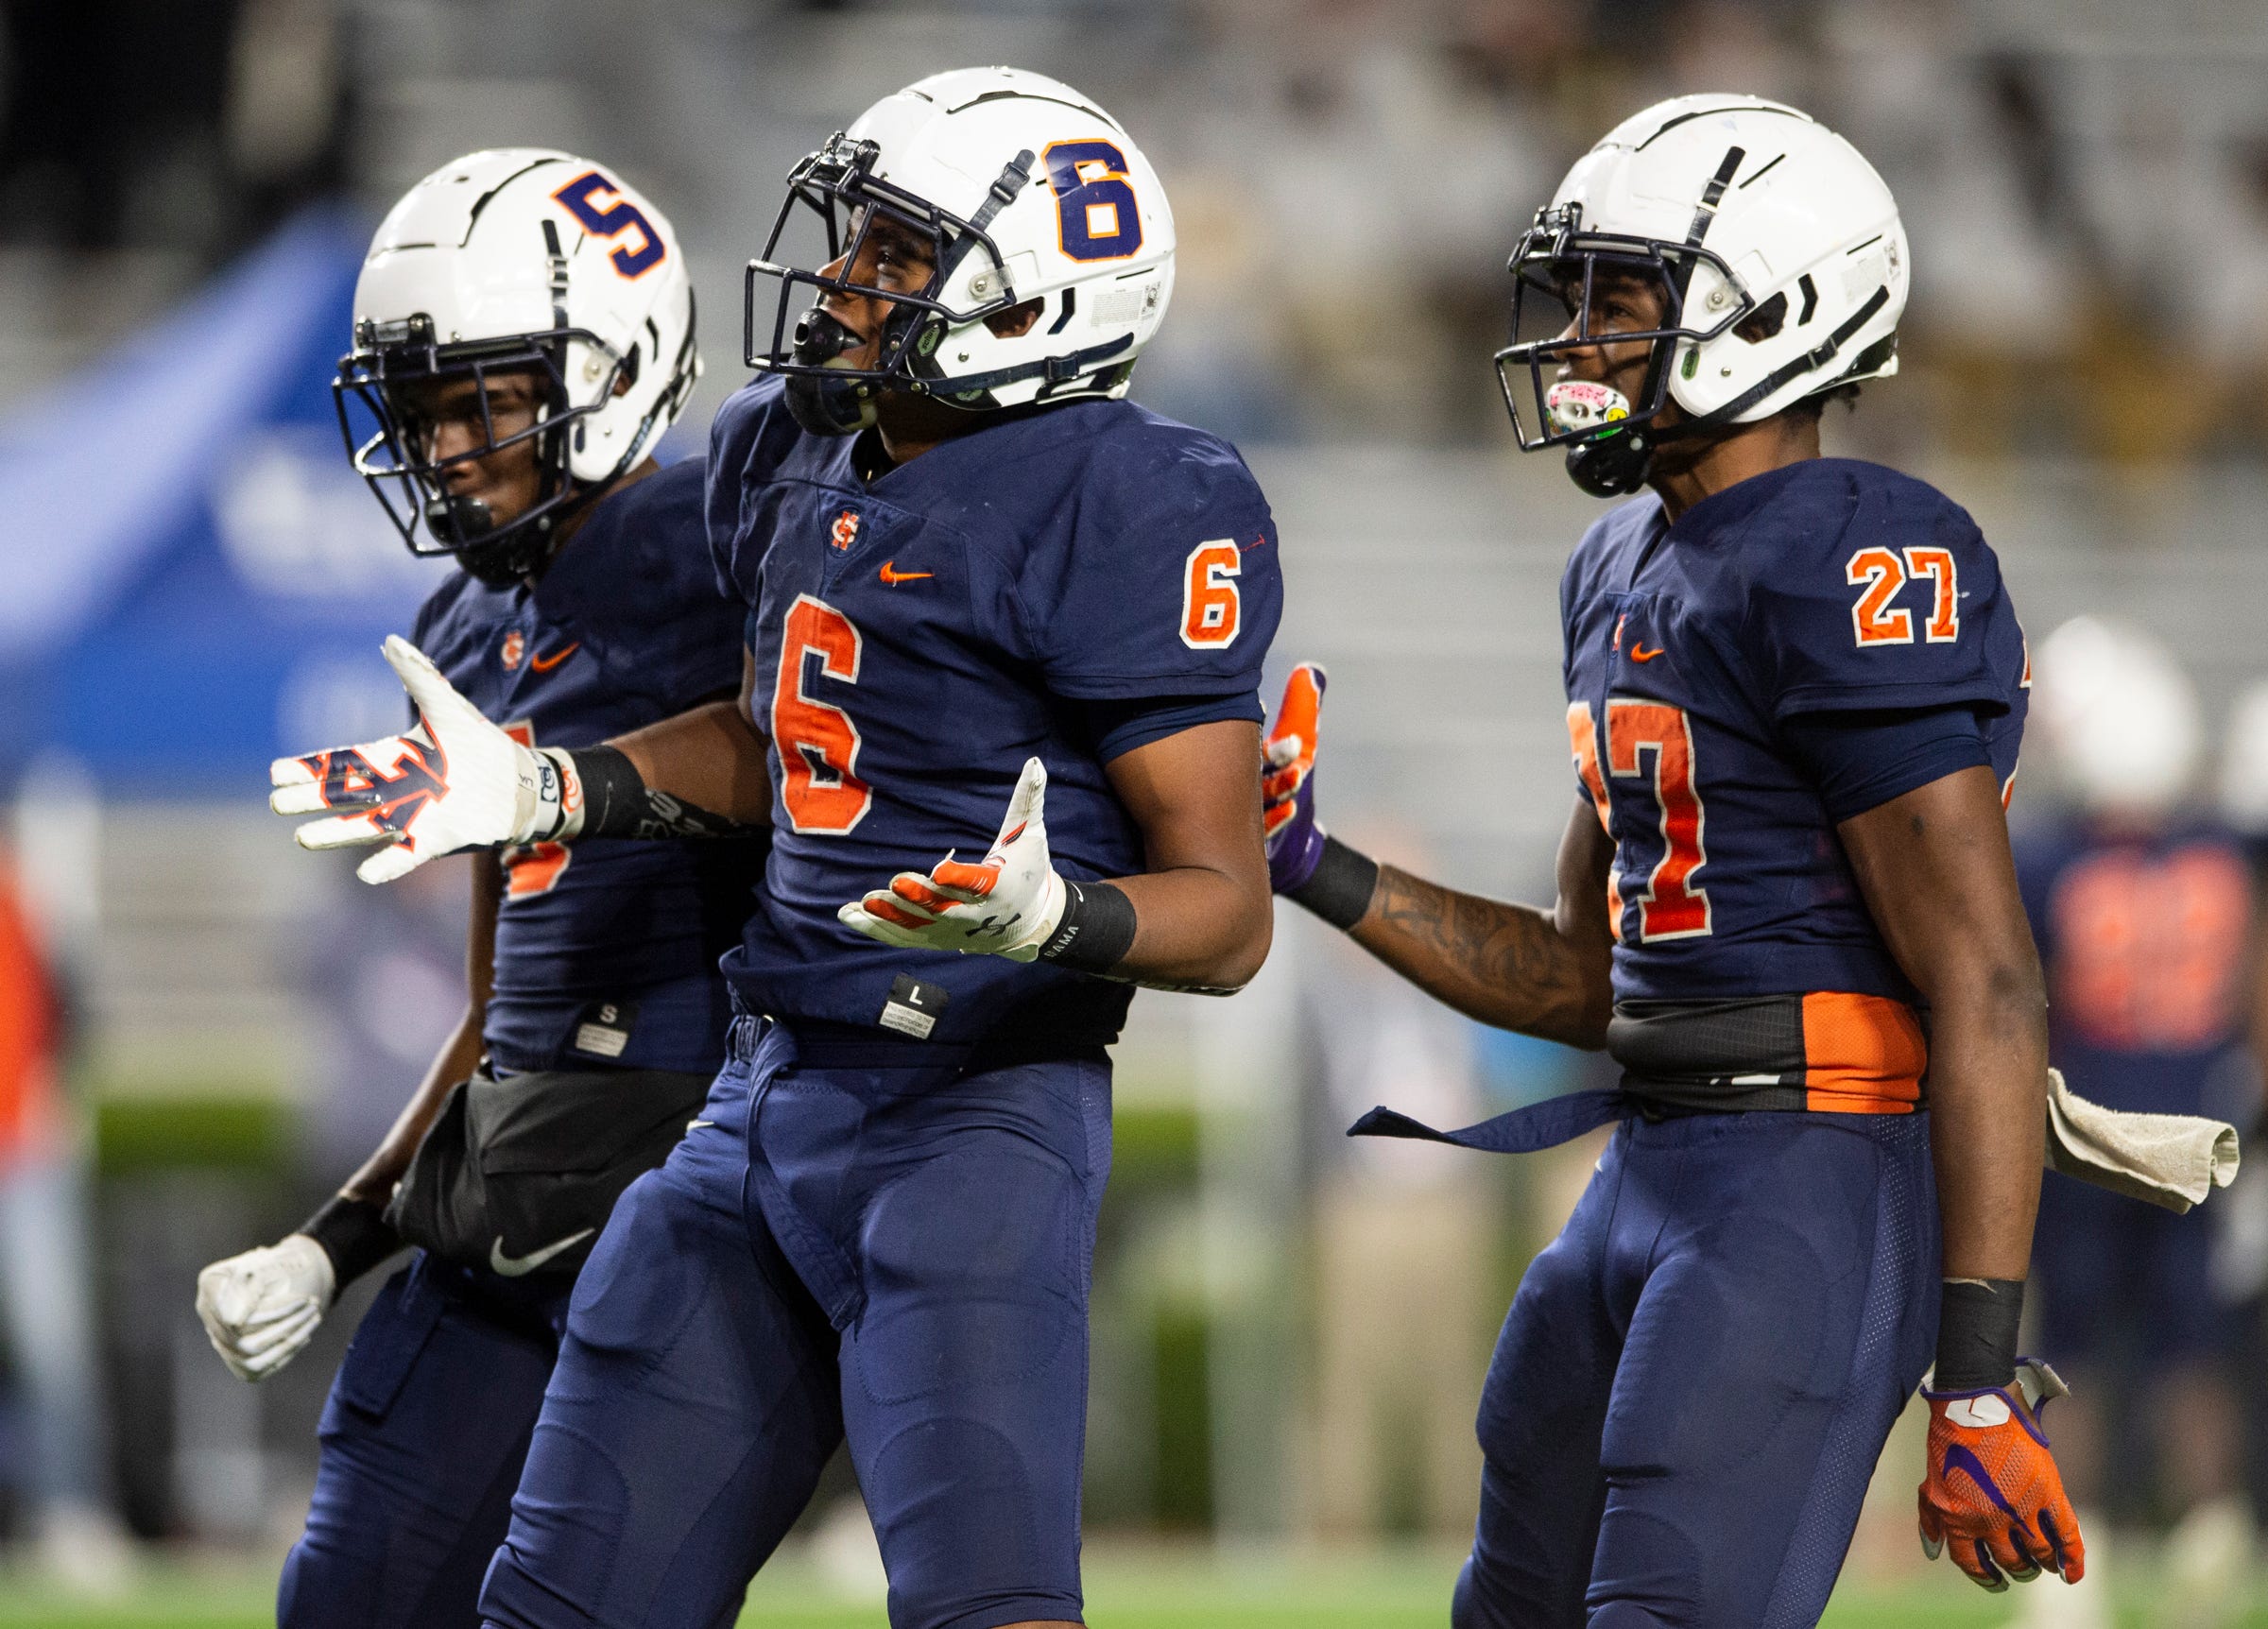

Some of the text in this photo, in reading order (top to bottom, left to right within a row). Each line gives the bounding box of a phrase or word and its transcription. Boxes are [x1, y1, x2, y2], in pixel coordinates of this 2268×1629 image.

[549, 170, 666, 282] 5
[1040, 138, 1144, 264] 6
[1178, 538, 1242, 650] 6
[1845, 545, 1960, 648] 27
[771, 593, 873, 836] 6
[599, 1004, 618, 1024] S
[909, 985, 923, 1006] L
